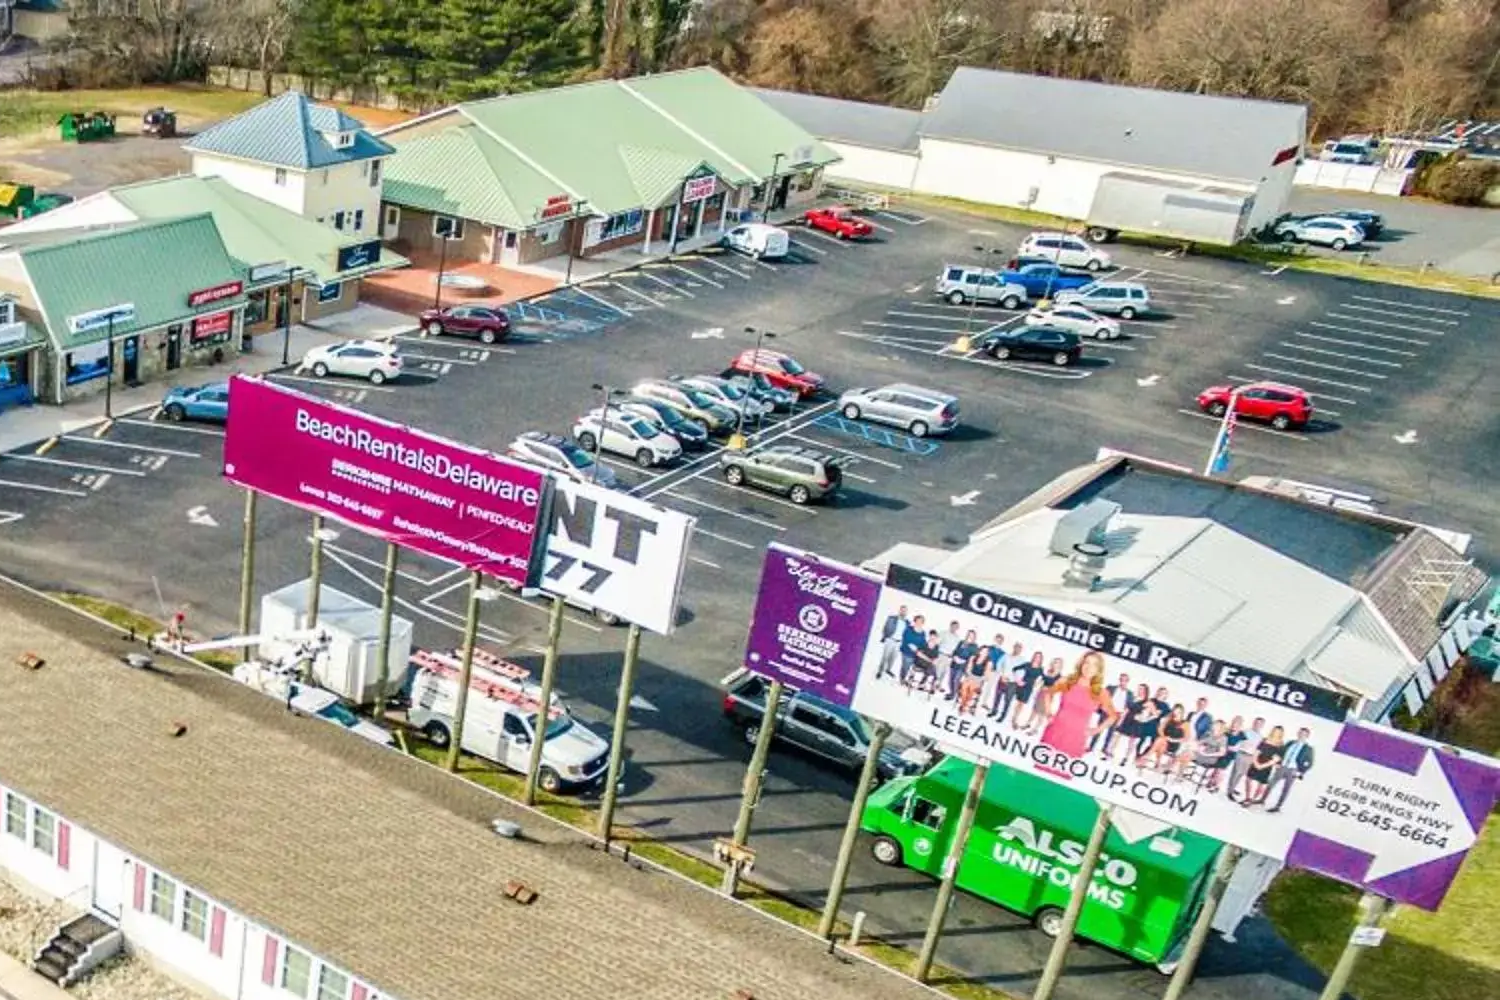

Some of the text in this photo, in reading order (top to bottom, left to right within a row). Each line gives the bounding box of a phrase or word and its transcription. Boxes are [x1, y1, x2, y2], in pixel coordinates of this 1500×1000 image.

[296, 408, 538, 506] BeachRentalsDelaware
[393, 479, 456, 510] HATHAWAY
[920, 574, 1307, 708] The One Name in Real Estate
[929, 707, 1199, 817] LEEANNGROUP.COM
[1351, 777, 1441, 812] TURN RIGHT
[1315, 795, 1448, 850] 302-645-6664
[1369, 799, 1414, 819] KINGS
[1416, 814, 1454, 833] HWY
[992, 842, 1125, 910] UNIFOMS
[994, 816, 1137, 887] ALSO
